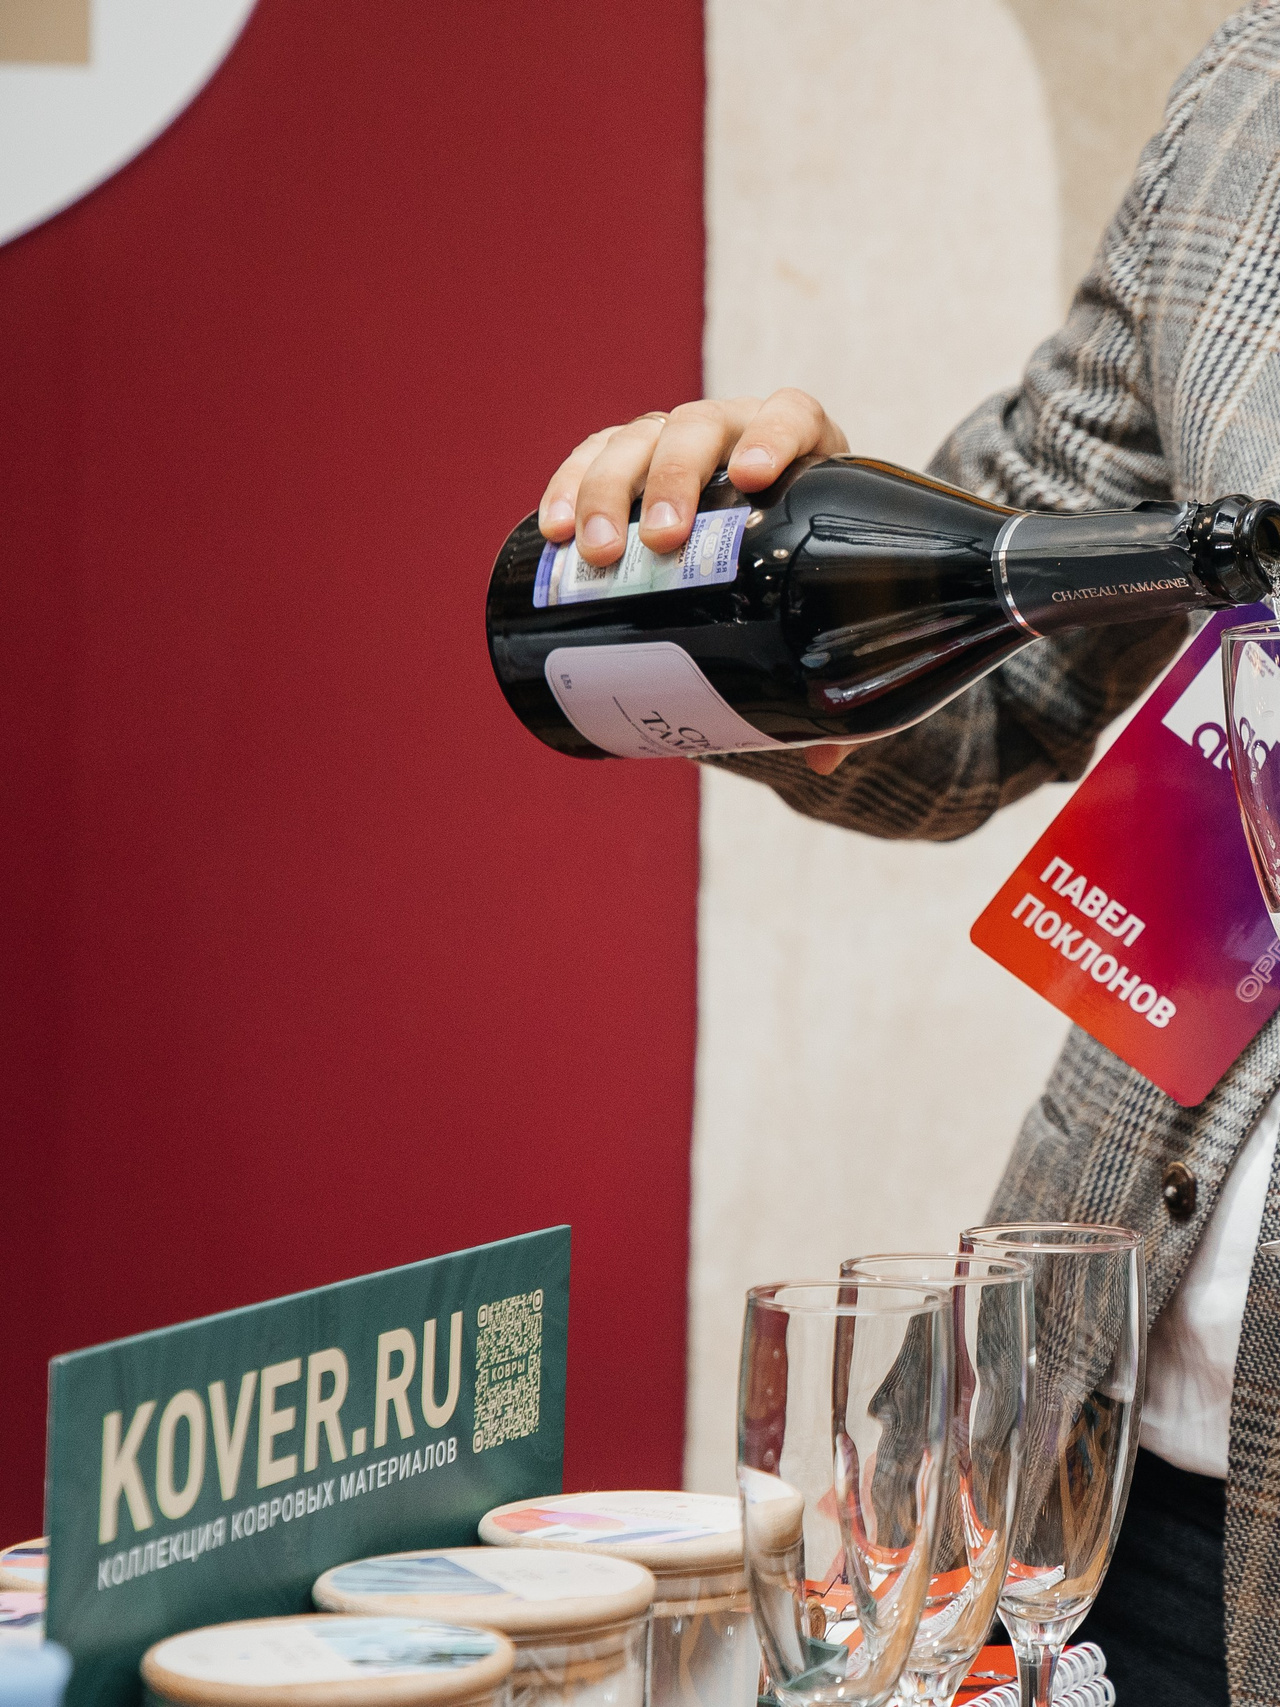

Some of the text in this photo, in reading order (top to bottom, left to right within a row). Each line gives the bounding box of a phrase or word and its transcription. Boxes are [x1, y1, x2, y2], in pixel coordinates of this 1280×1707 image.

[715, 516, 733, 574] ФЕДЕРАЦИЯ
[721, 514, 739, 573] РОССИЙСКАЯ
[1051, 577, 1189, 602] CHATEAU TAMAGNE
[1039, 856, 1146, 948] ПАВЕЛ
[1011, 892, 1177, 1029] ПОКЛОНОВ
[491, 1358, 526, 1382] КОВРЫ
[99, 1311, 463, 1545] KOVER.RU
[98, 1436, 458, 1591] КОЛЛЕКЦИЯ КОВРОВЫХ МАТЕРИАЛОВ
